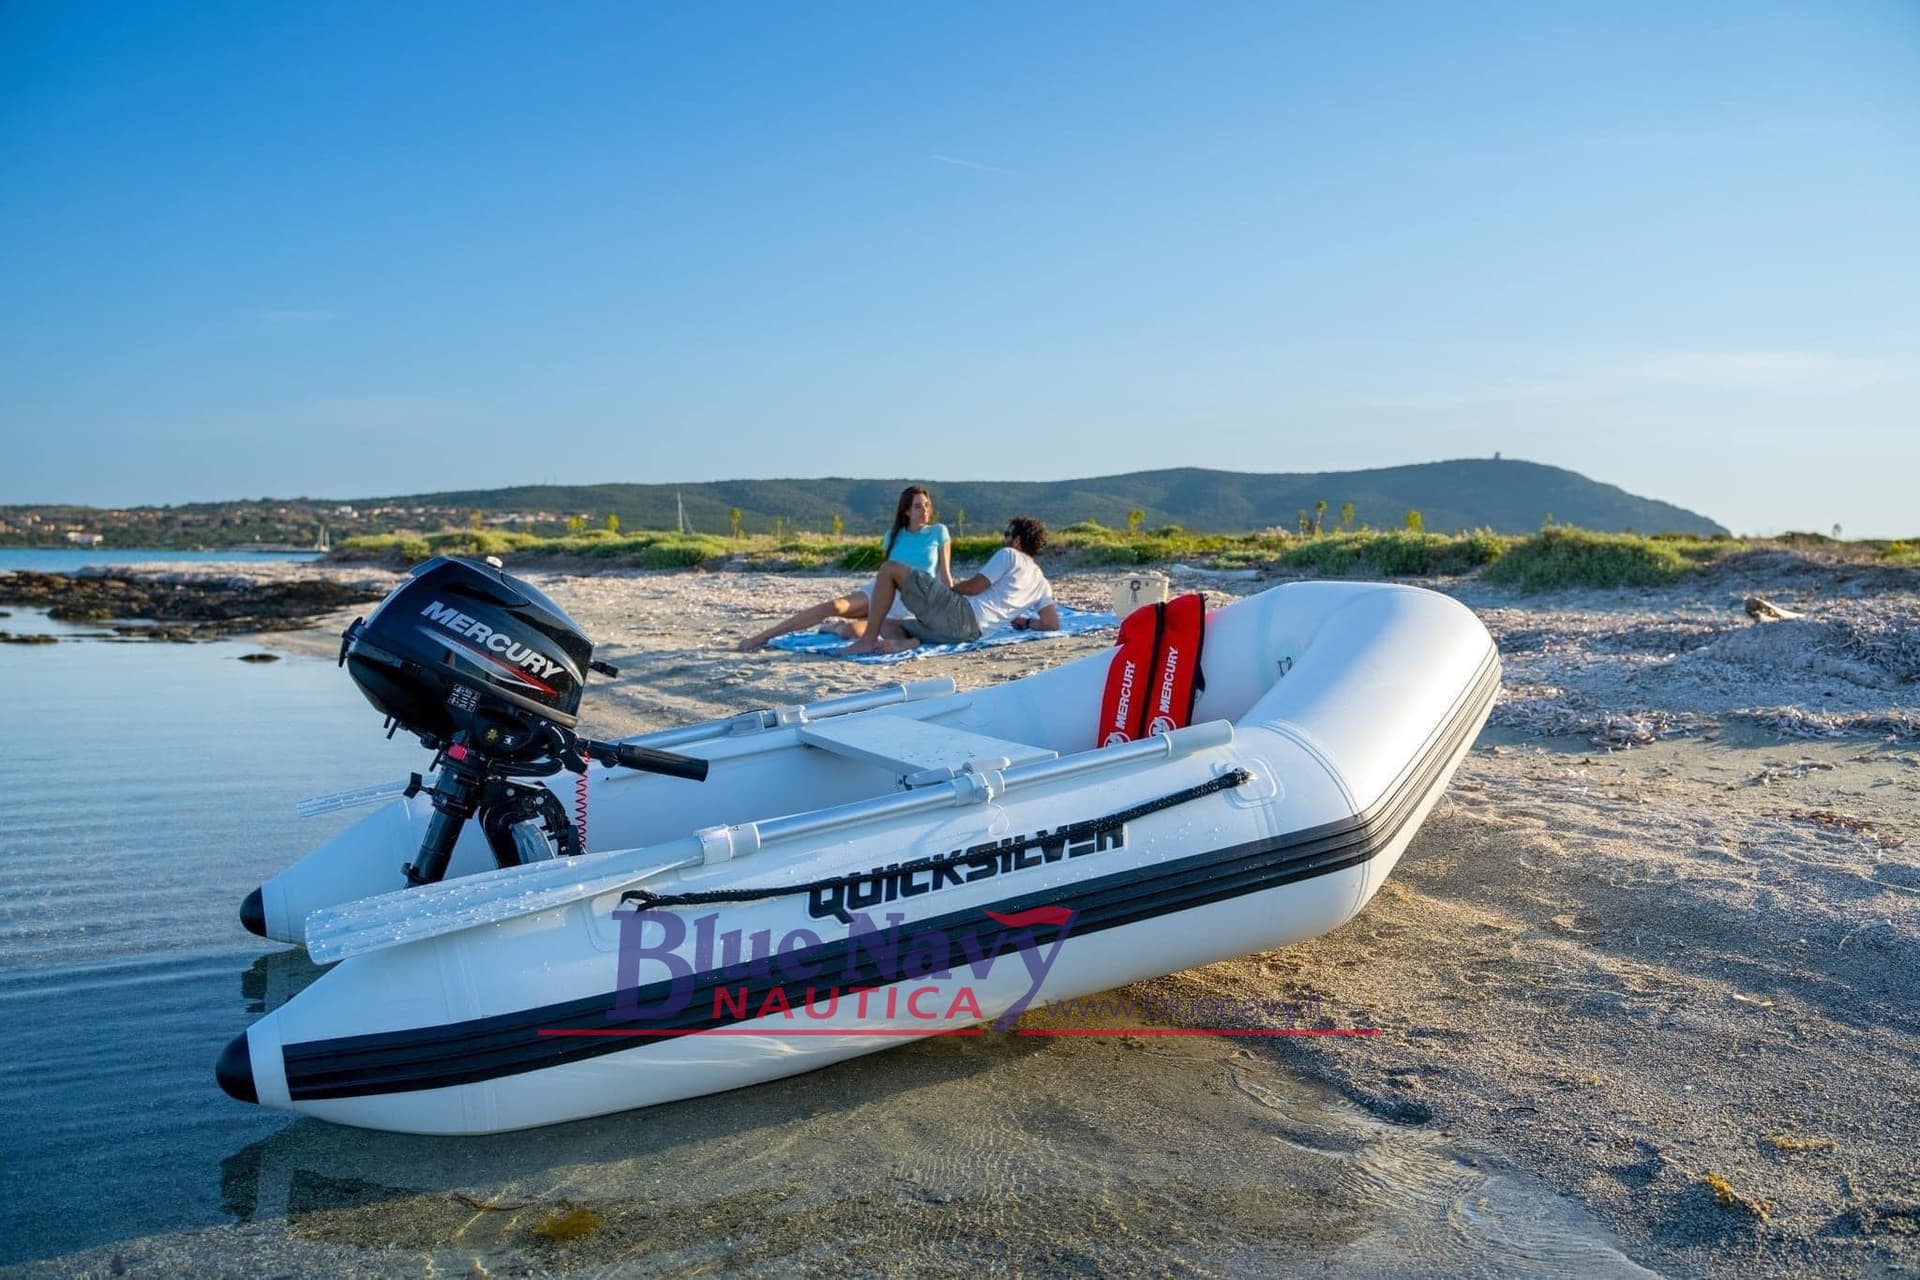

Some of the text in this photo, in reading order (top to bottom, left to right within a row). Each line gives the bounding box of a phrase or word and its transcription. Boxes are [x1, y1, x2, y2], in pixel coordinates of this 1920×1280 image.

[420, 600, 565, 680] MERCURY
[1114, 659, 1135, 730] MERCURY
[1159, 645, 1178, 714] MERCURY
